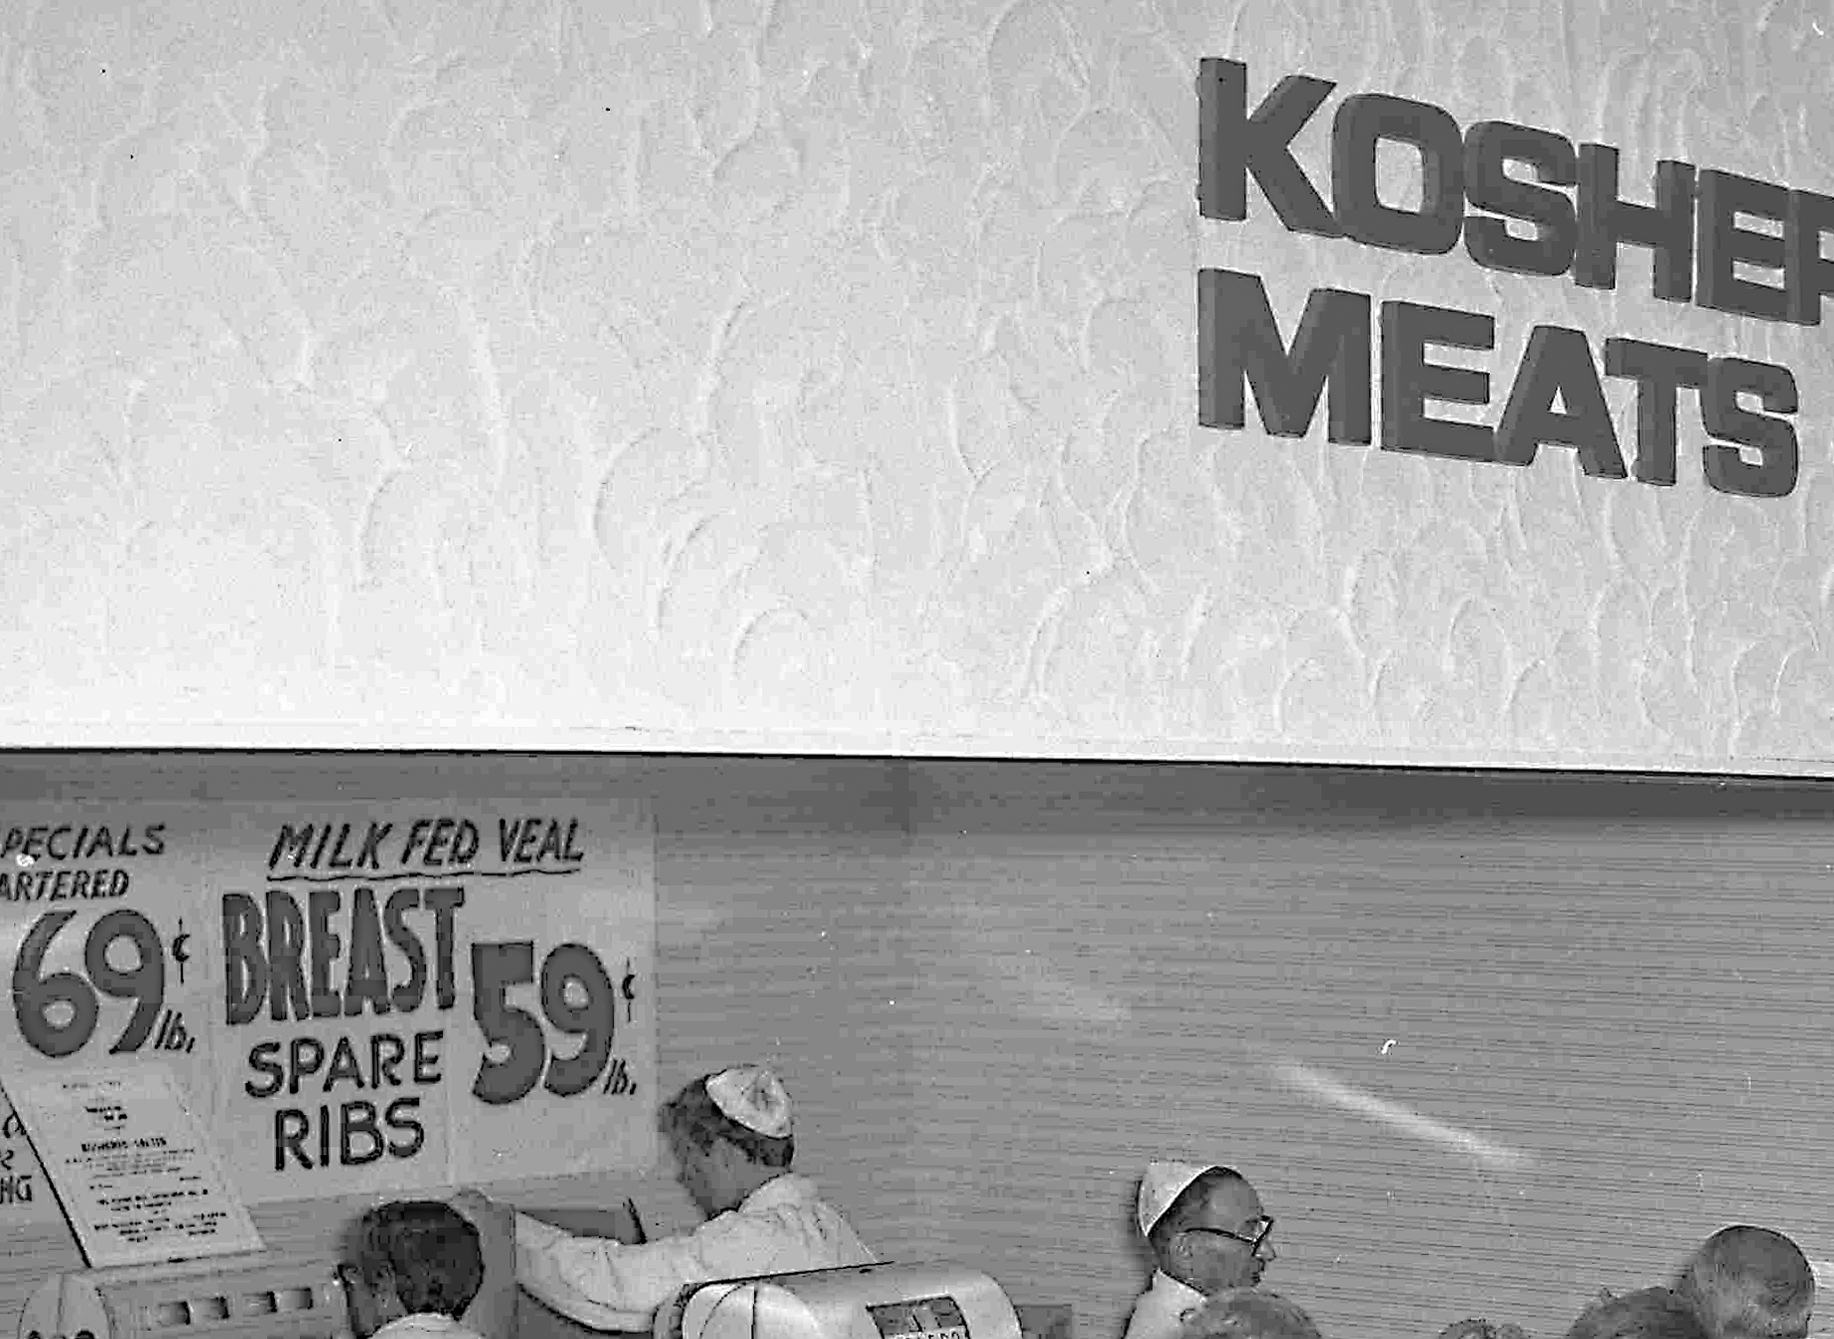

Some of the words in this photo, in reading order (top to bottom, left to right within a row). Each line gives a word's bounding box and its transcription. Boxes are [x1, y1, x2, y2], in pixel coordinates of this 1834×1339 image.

[1198, 267, 1799, 499] MEATS
[267, 823, 393, 870] MILK
[400, 817, 480, 866] FED
[497, 817, 585, 864] VEAL
[221, 886, 466, 1026] BREAST
[244, 1029, 444, 1099] SPARE
[273, 1097, 425, 1171] RIBS
